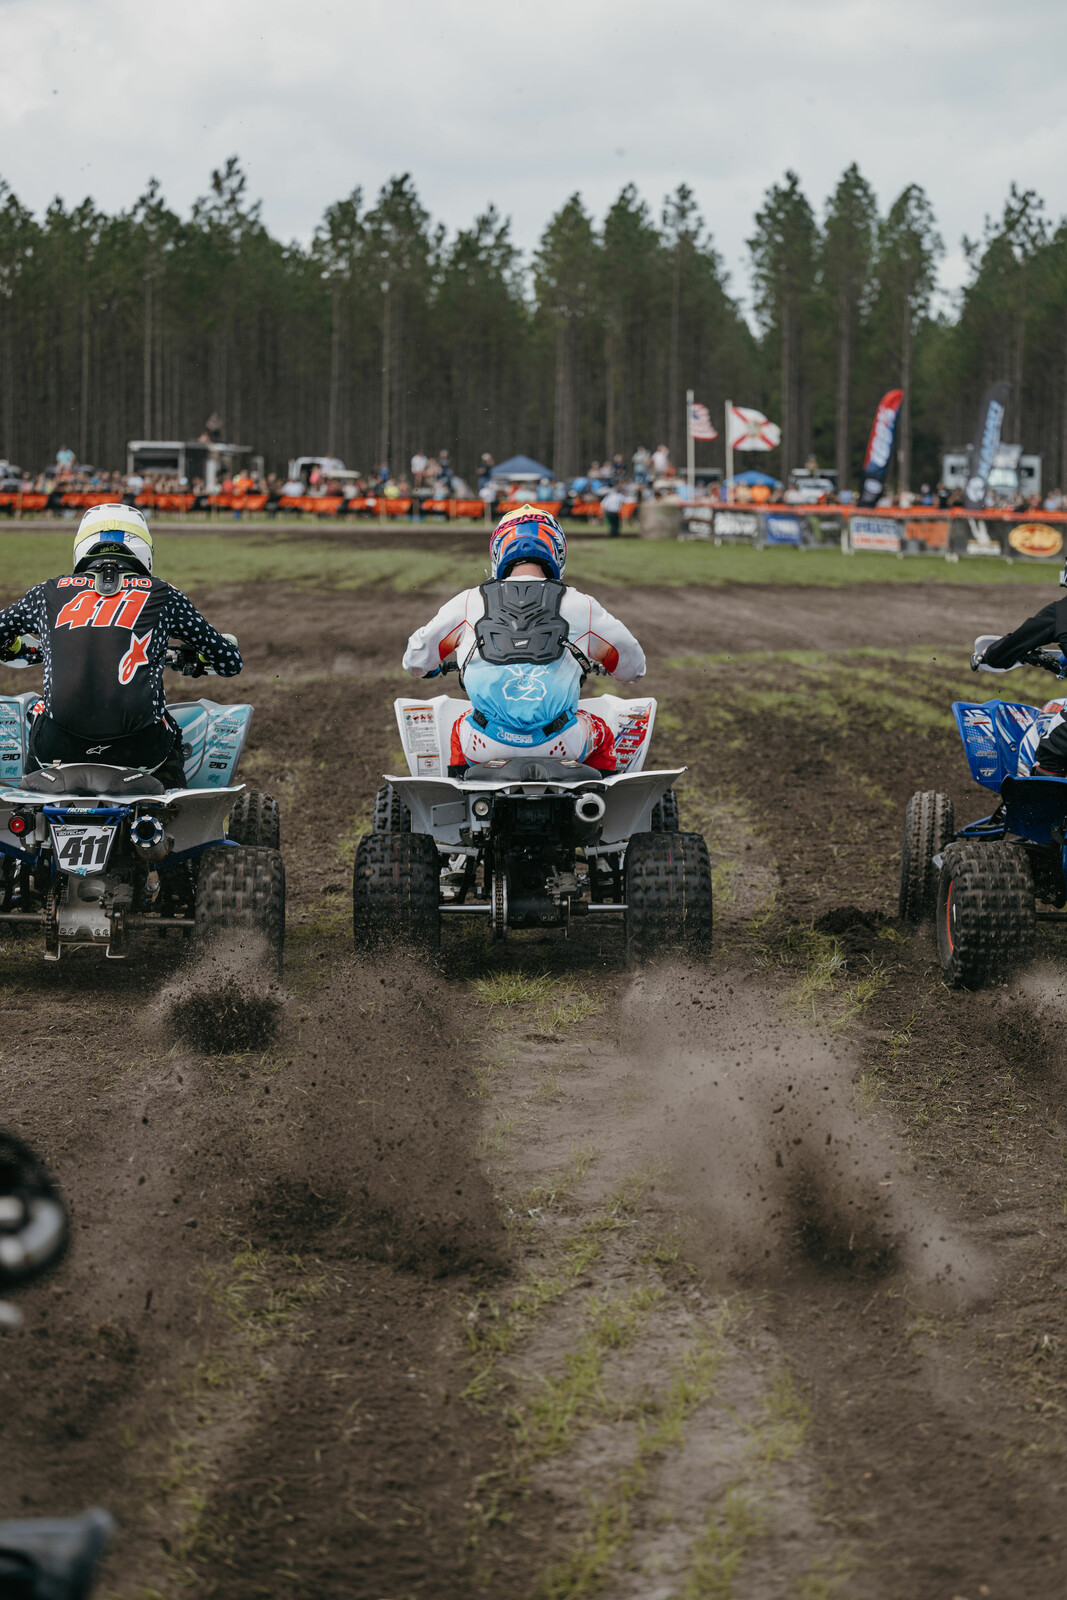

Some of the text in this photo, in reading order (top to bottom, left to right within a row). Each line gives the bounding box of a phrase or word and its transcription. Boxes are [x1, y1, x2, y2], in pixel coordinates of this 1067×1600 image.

[56, 576, 152, 588] BOTHO
[54, 589, 151, 631] 411
[59, 834, 110, 866] 411
